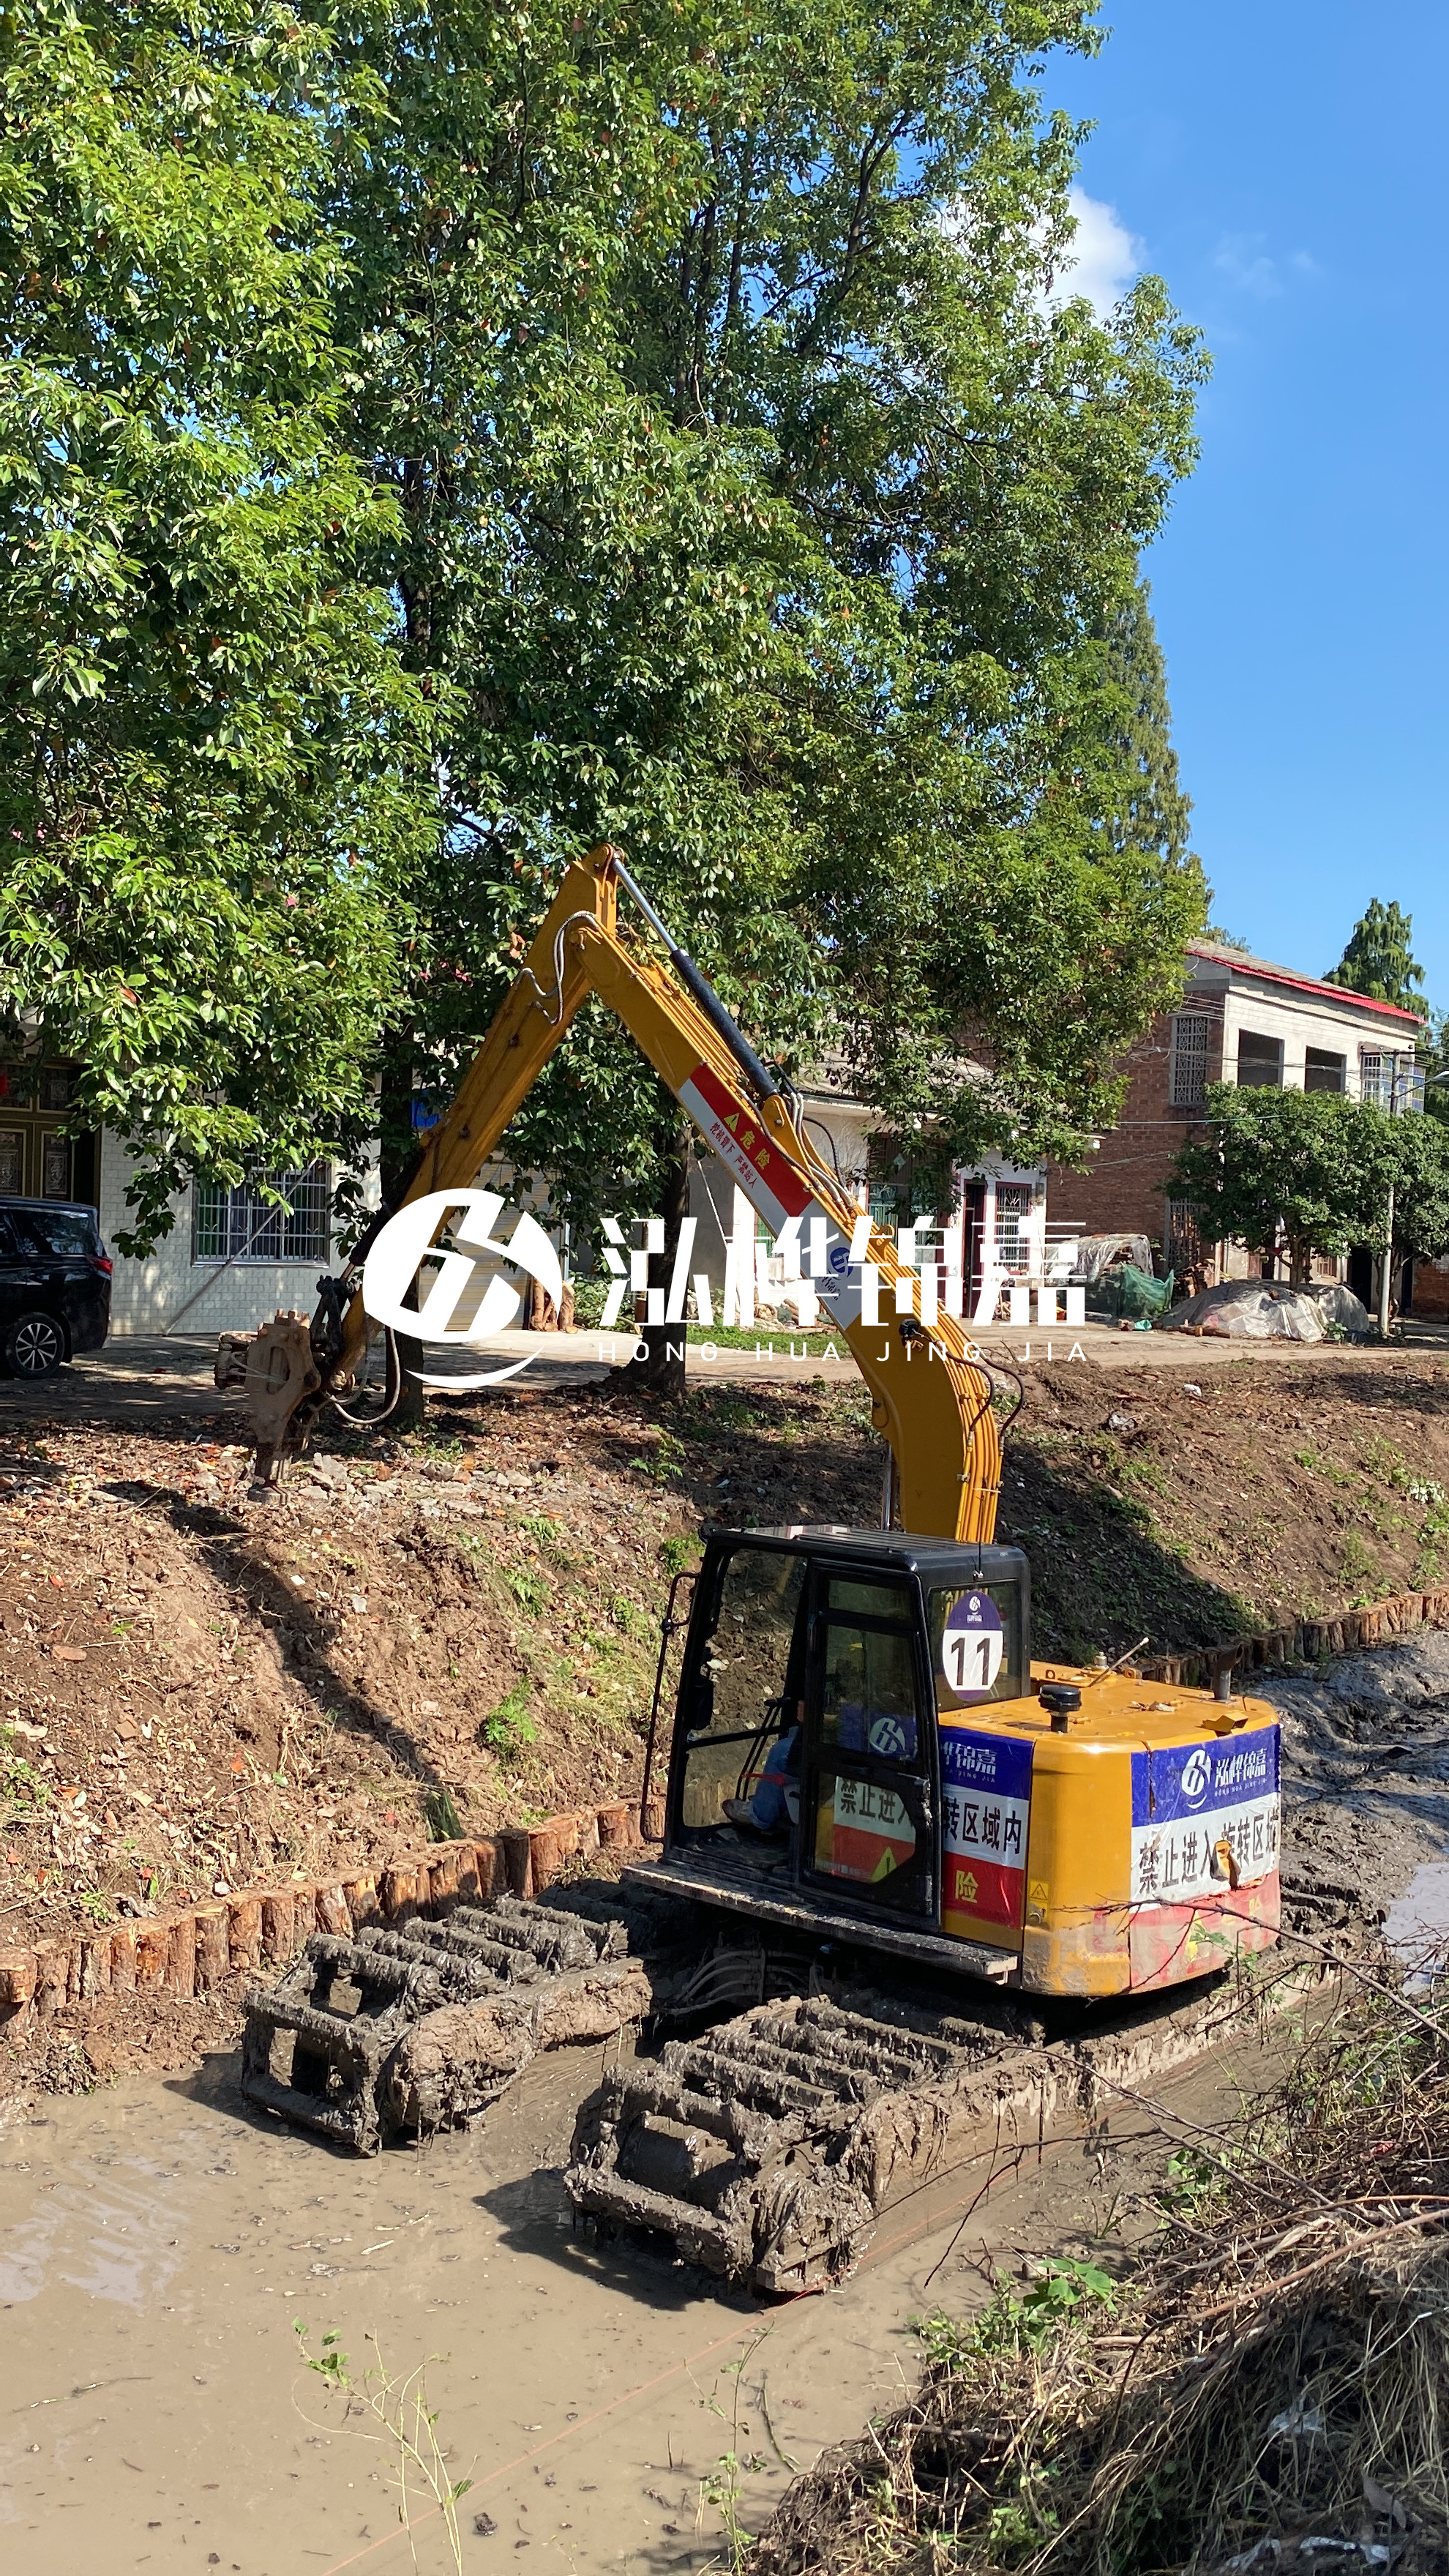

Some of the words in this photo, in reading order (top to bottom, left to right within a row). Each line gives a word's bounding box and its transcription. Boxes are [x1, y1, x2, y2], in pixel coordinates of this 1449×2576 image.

[740, 1130, 770, 1170] 危险
[951, 1638, 990, 1686] 11
[955, 1870, 979, 1904] 险
